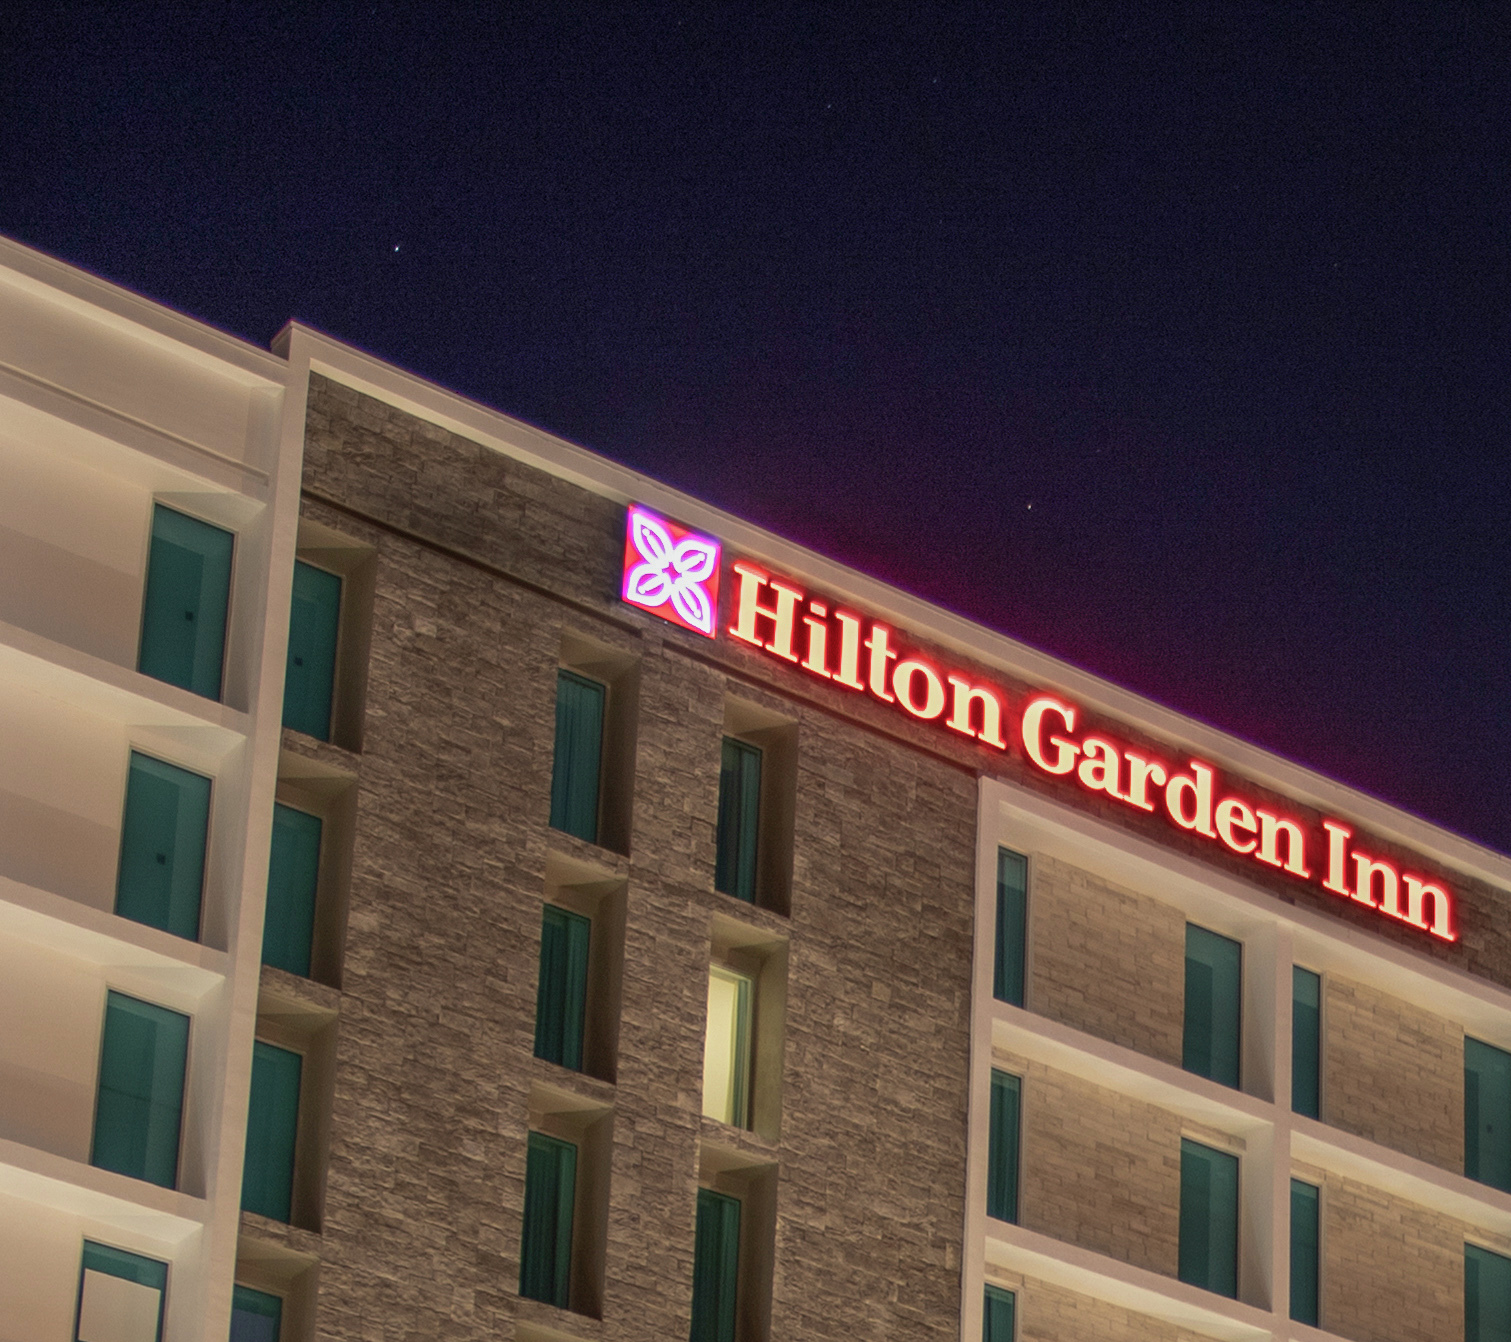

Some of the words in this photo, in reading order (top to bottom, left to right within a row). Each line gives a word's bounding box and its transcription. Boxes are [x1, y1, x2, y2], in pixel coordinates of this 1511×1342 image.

[728, 561, 1006, 751] Hilton
[1021, 697, 1311, 879] Garden
[1322, 820, 1457, 943] Inn
